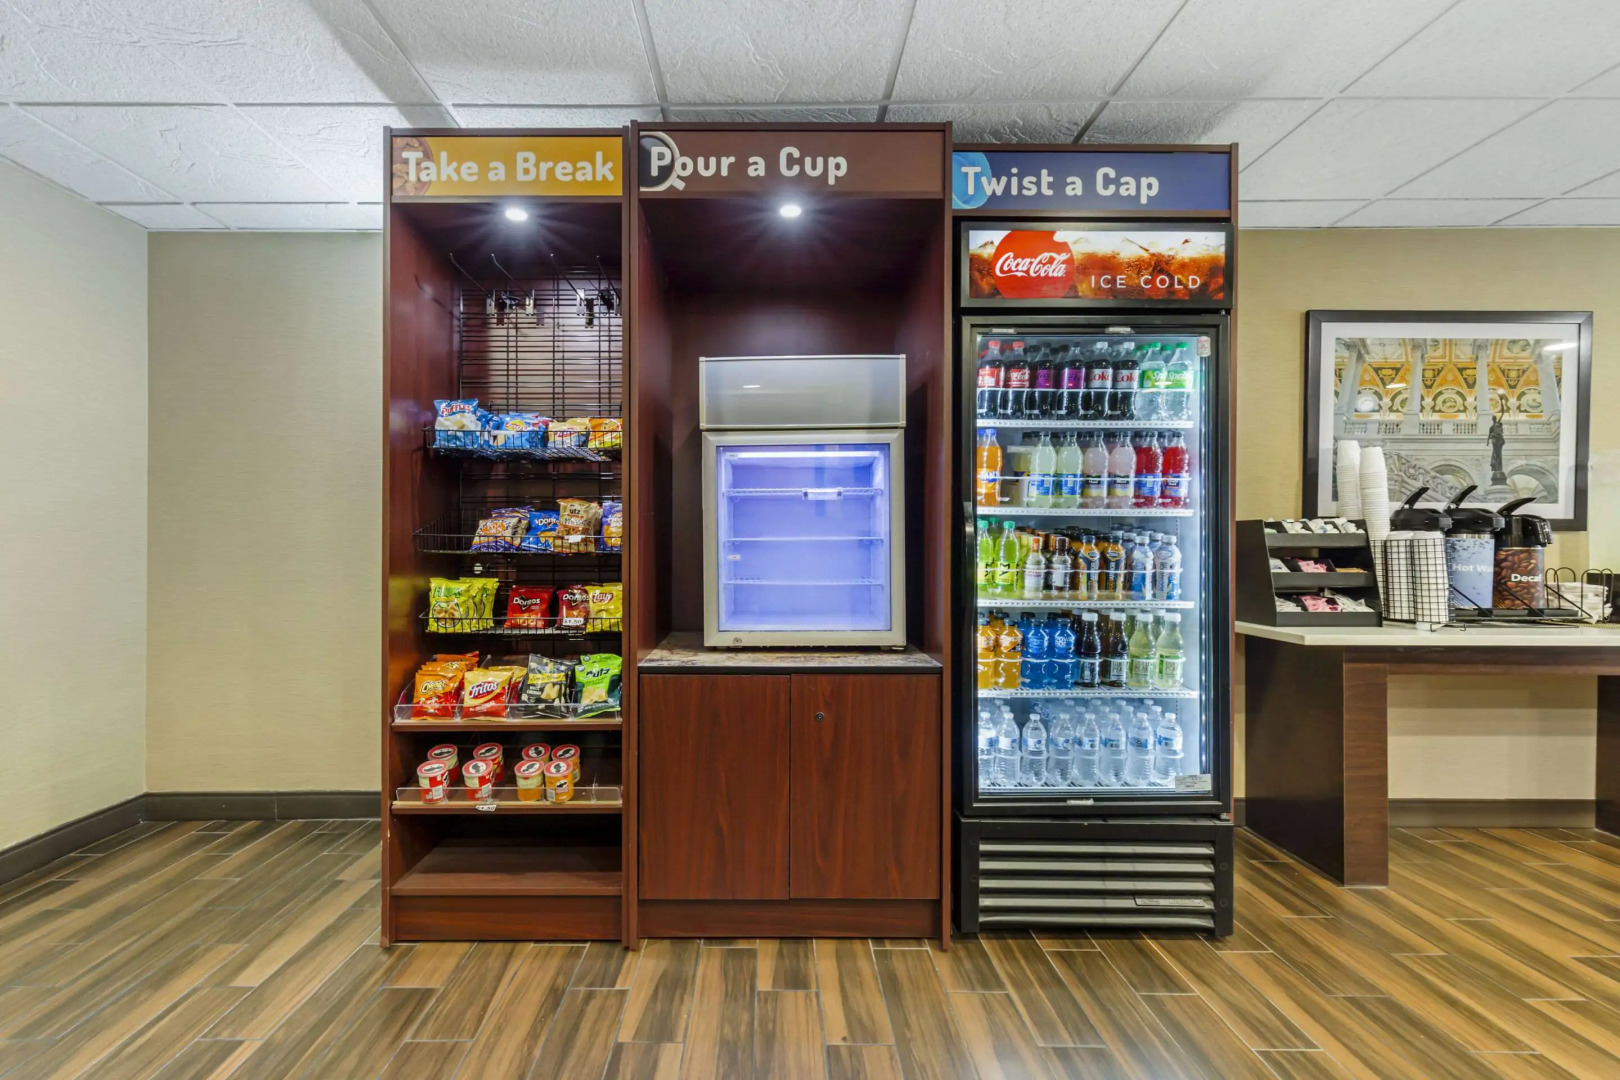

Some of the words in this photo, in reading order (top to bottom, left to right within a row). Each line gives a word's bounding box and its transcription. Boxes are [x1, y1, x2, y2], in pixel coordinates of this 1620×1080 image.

[401, 151, 479, 182] Take
[487, 161, 506, 182] a
[515, 151, 614, 182] Break
[650, 146, 735, 177] Pour
[747, 156, 766, 177] a
[779, 146, 848, 186] Cup
[960, 166, 1054, 196] Twist
[1065, 176, 1083, 196] a
[1096, 166, 1160, 205] Cap
[994, 251, 1073, 278] Coca-Cola
[1091, 275, 1127, 289] ICE
[1140, 275, 1201, 289] COLD
[1452, 564, 1474, 572] Hot
[513, 597, 541, 606] Doritos
[470, 682, 498, 698] Fritos
